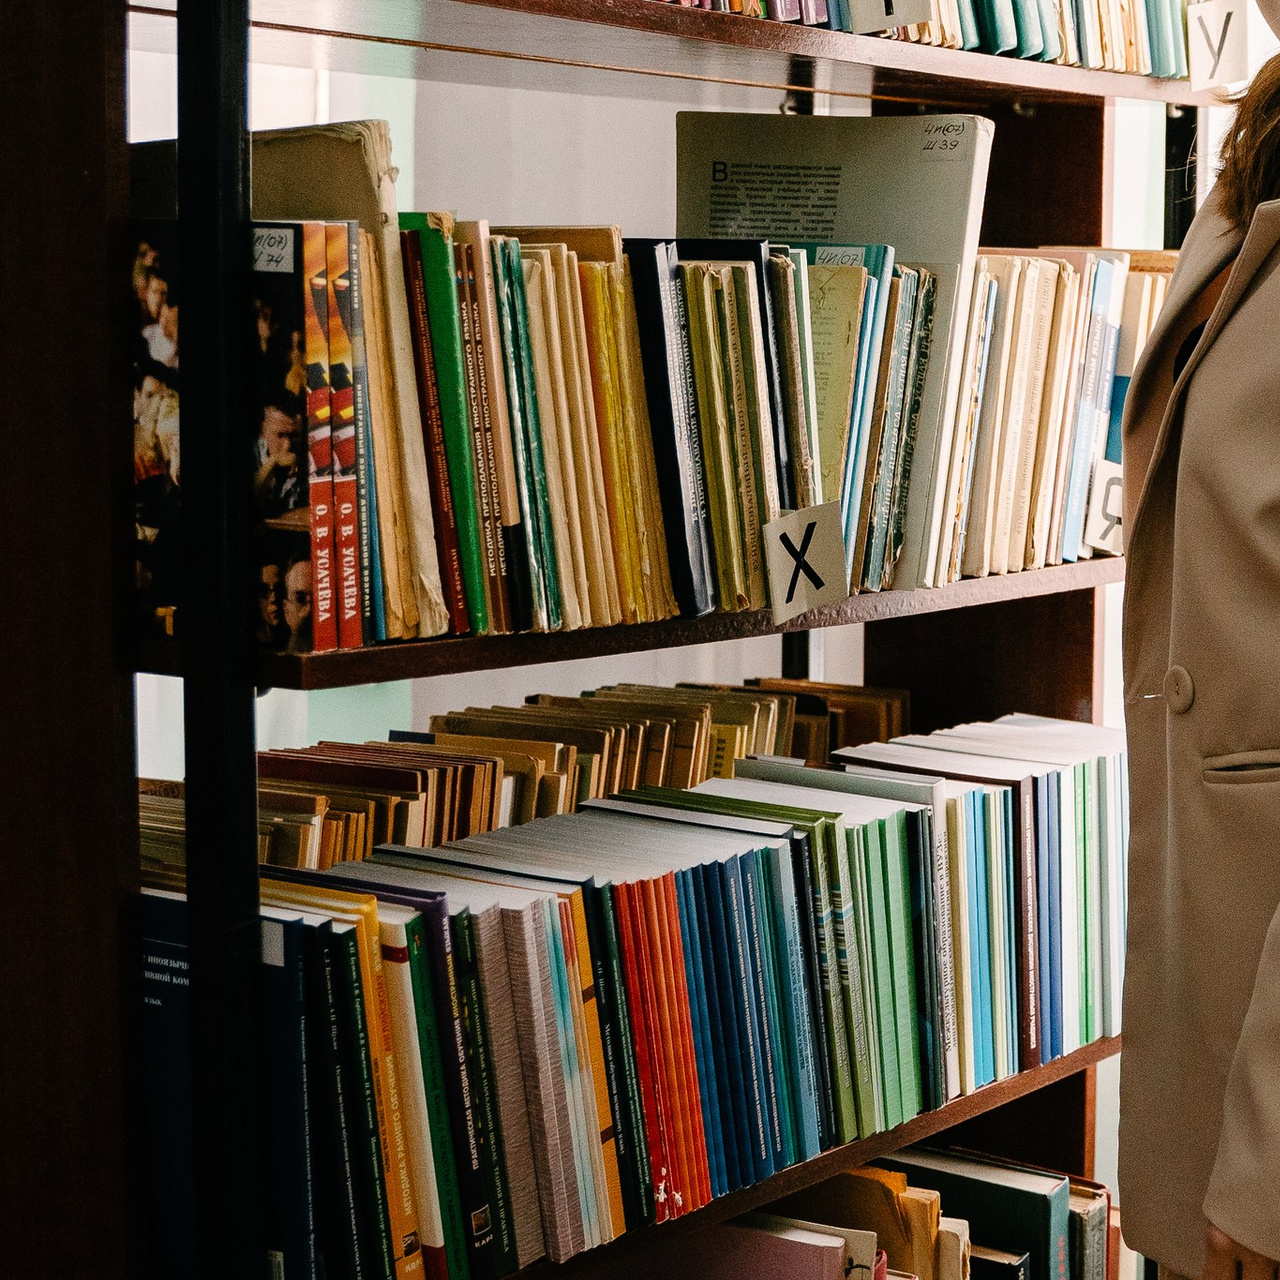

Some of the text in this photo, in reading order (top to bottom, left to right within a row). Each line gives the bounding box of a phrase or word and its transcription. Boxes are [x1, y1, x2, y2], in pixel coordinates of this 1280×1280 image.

[1197, 10, 1234, 80] У
[1034, 314, 1046, 370] ИНОСТРАННЫМ
[1041, 276, 1050, 309] ЯЗЫКАМ
[1091, 307, 1104, 355] ЯЗЫКАМ
[460, 301, 497, 576] МЕТОДИКА ПРЕПОДАВАНИЯ ИНОСТРАННОГО ЯЗЫКА
[472, 301, 507, 575] МЕТОДИКА ПРЕПОДАВАНИЯ ИНОСТРАННОГО ЯЗЫКА
[675, 278, 706, 517] И ПРЕПОДАВАНИЕ ИНОСТРАННЫХ ЯЗЫКОВ
[727, 292, 759, 571] ФУНКЦИОНАЛЬНЫЙ СТИЛЬ НАУЧНОЙ ПРОЗЫ
[881, 480, 892, 526] ЧТЕНИЕ
[896, 355, 907, 398] УСТНАЯ
[902, 319, 912, 349] РЕЧЬ
[904, 357, 927, 469] ПЕРЕВОД УСТНАЯ
[356, 383, 364, 453] ИНОСТРАННЫЙ
[360, 499, 369, 565] ДОШКОЛЬНОМ
[315, 504, 333, 621] О. В. УСАЧЁВА
[340, 503, 357, 619] О. В. УСАЧЁВА
[779, 520, 826, 604] Х
[935, 833, 944, 871] ВУЗе:
[937, 883, 948, 956] образование
[375, 974, 392, 1051] АНГЛИЙСКОМУ
[441, 915, 479, 1169] ПРАКТИЧЕСКАЯ МЕТОДИКА ОБУЧЕНИЯ ИНОСТРАННЫМ ЯЗЫКАМ
[603, 1023, 614, 1059] Методика
[941, 961, 952, 1051] Межкультурное
[385, 1055, 399, 1109] ОБУЧЕНИЯ
[469, 978, 482, 1043] ИНОСТРАННЫЙ
[482, 1078, 493, 1129] НАЧАЛЬНОЙ
[492, 1166, 502, 1198] ТЕОРИЯ
[498, 1208, 509, 1252] ПРАКТИКА
[392, 1112, 405, 1157] РАННЕГО
[398, 1161, 412, 1215] МЕТОДИКА
